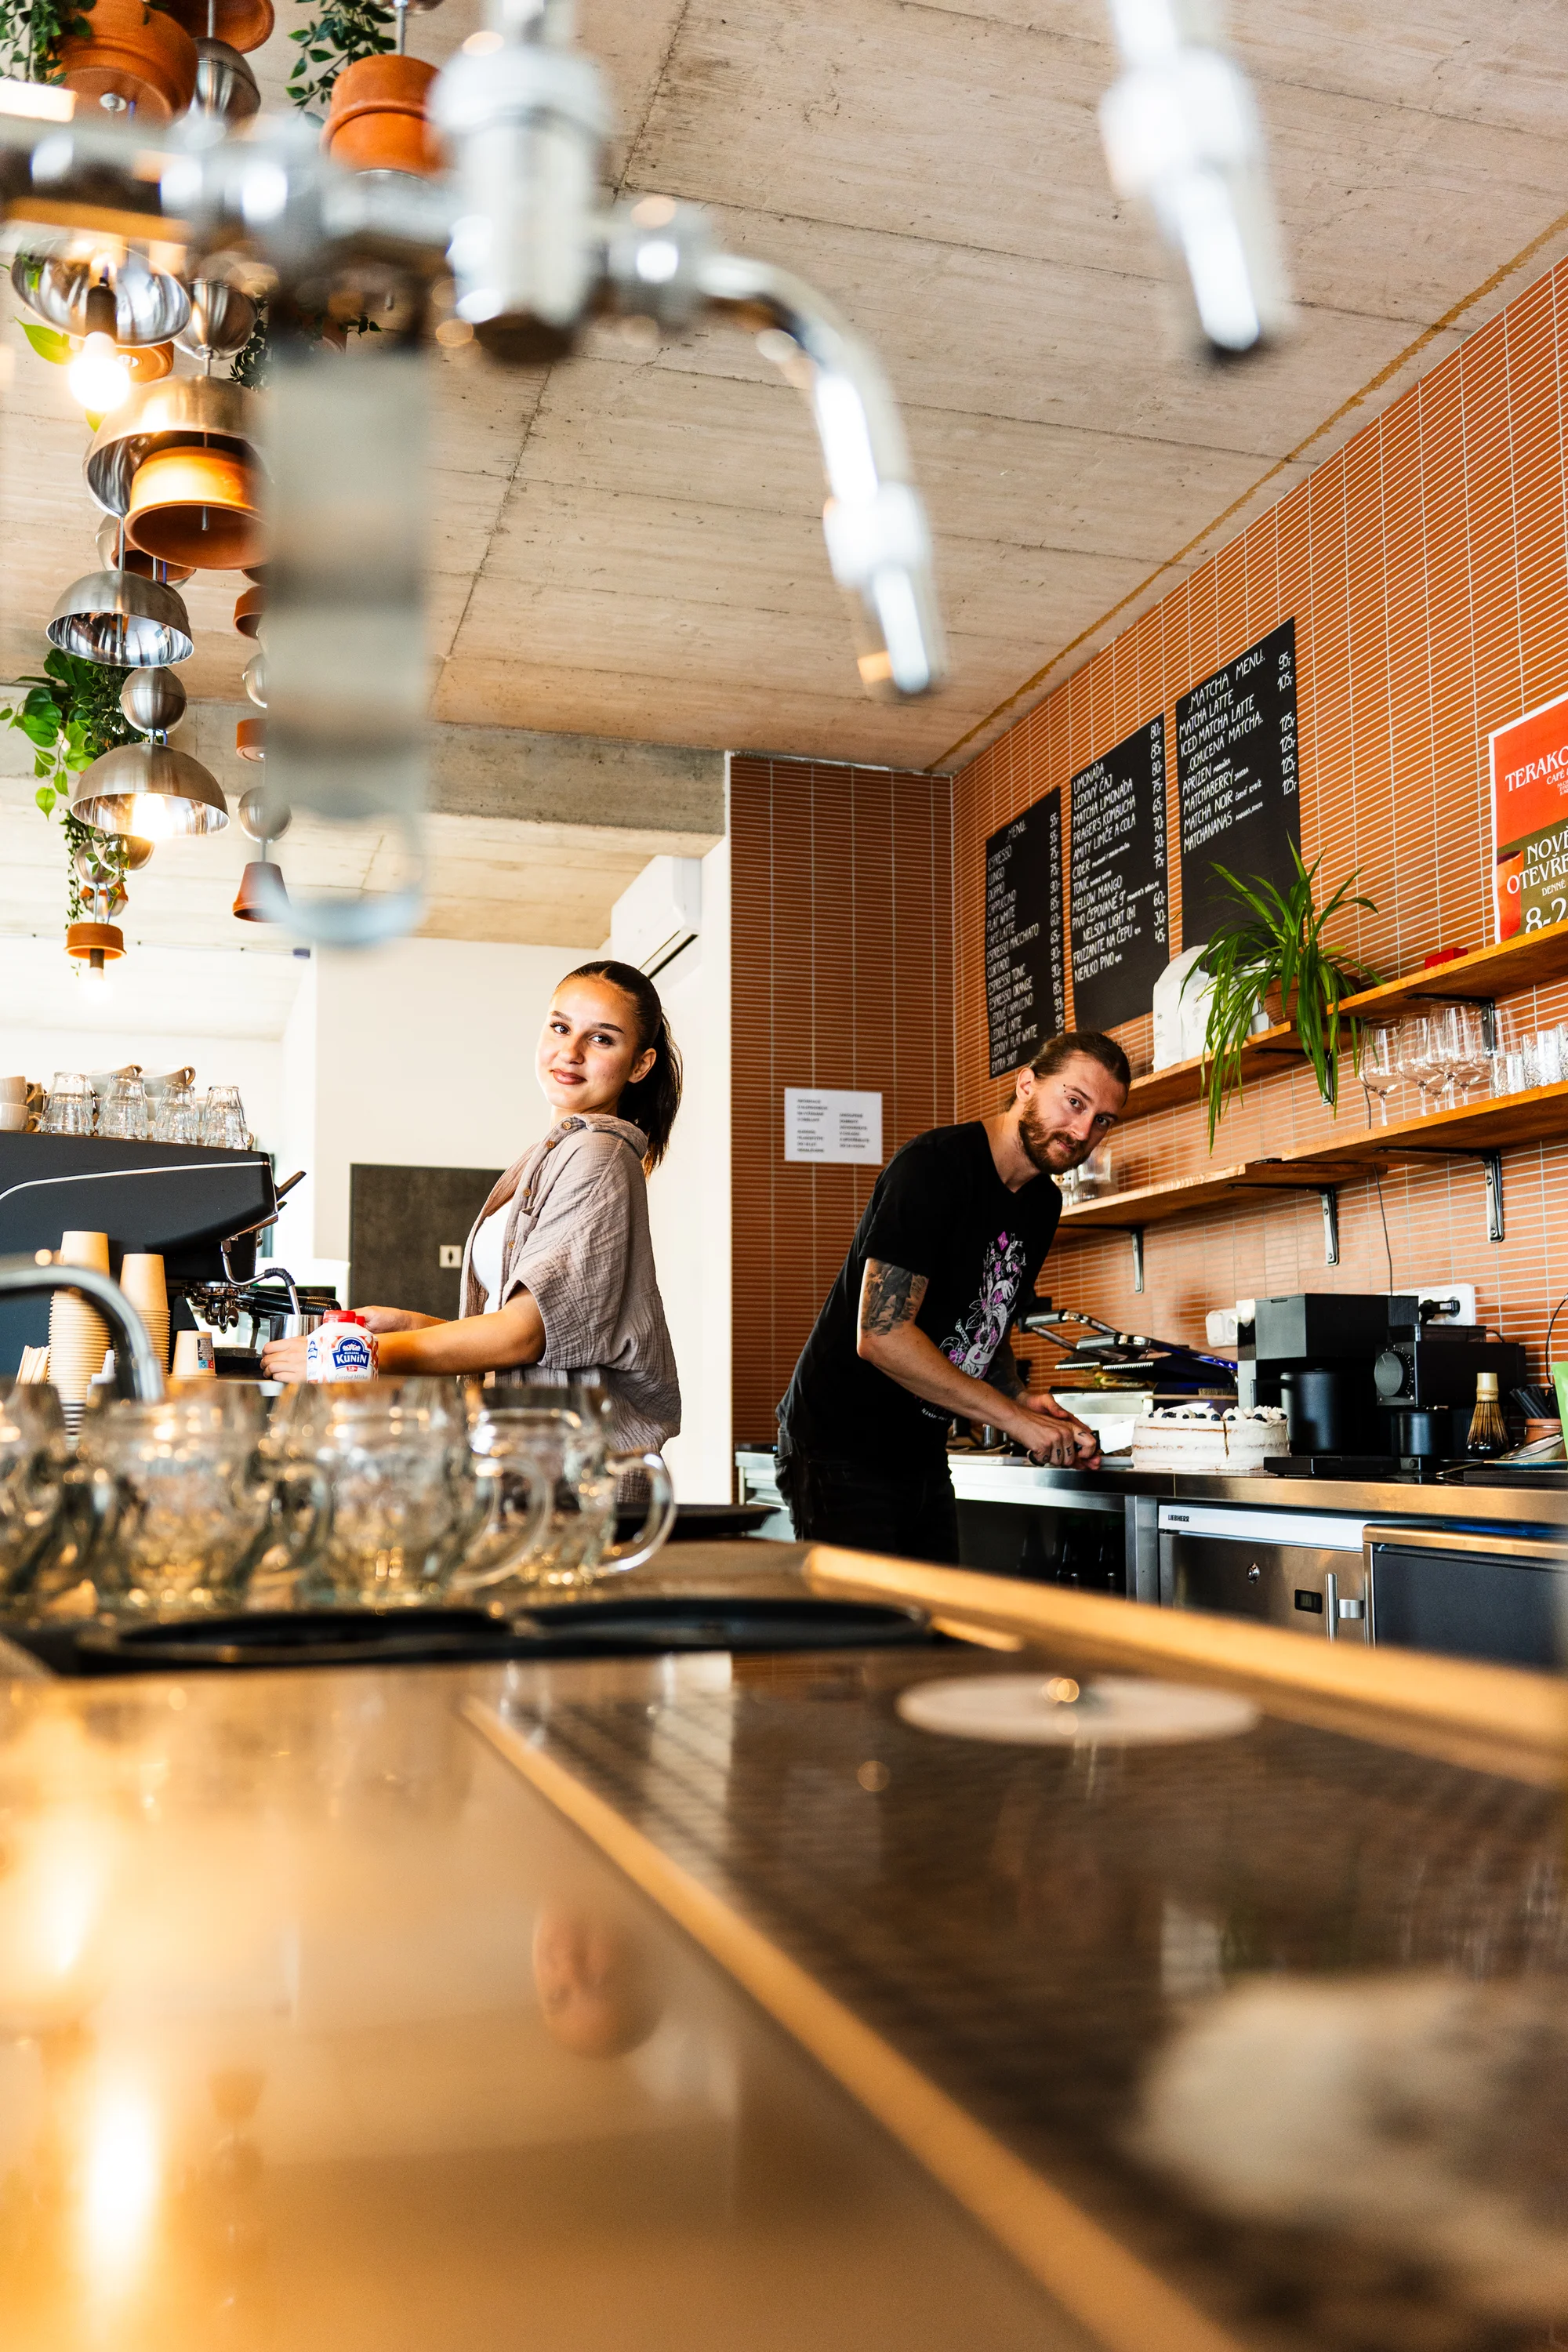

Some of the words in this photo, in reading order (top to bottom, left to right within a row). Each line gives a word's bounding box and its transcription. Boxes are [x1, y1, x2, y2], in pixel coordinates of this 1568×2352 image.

[1179, 708, 1207, 739] MATCHA
[1210, 689, 1233, 718] LATTE
[1181, 735, 1197, 757] ICED
[1200, 713, 1228, 744] MATCHA
[1232, 694, 1254, 723] LATTE
[1073, 762, 1104, 794] LIMONÁDA
[1182, 763, 1211, 797] APRIZEN
[1184, 768, 1233, 815] MATCHABERRY
[1546, 768, 1565, 784] CAFÉ
[1073, 801, 1098, 828] MATCHA
[1100, 778, 1132, 811] LIMONÁDA
[1074, 782, 1098, 811] LEDOVÝ
[1099, 774, 1112, 793] ČAJ
[1103, 795, 1135, 826] KOMBUCHA
[1184, 804, 1211, 834] MATCHA
[1215, 790, 1233, 813] NOIR
[1073, 840, 1092, 862] AMITY
[1115, 823, 1119, 837] A
[1120, 813, 1135, 832] COLA
[1184, 811, 1232, 854] MATCHANANAS
[988, 845, 1012, 871] ESPRESSO
[1073, 858, 1090, 880] CIDER
[988, 866, 1004, 886] LUNGO
[988, 881, 1004, 902] DOPPIO
[1073, 877, 1089, 895] TONIC
[988, 889, 1016, 916] CAPPUCCINO
[1073, 891, 1095, 914] MELLOW
[1098, 875, 1122, 900] MANGO
[987, 915, 999, 933] FLAT
[1000, 905, 1015, 924] WHITE
[1073, 913, 1085, 931] PIVO
[1087, 891, 1118, 923] ČEPOVANÉ
[1083, 920, 1106, 942] NELSON
[1109, 909, 1124, 929] LIGHT
[987, 941, 1008, 964] ESPRESSO
[1010, 923, 1039, 950] MACCHIATO
[1000, 920, 1015, 940] LATTE
[1073, 938, 1105, 966] FRIZZANTE
[1106, 933, 1116, 948] NA
[1116, 924, 1132, 943] ČEPU
[988, 956, 1009, 978] CORTADO
[988, 972, 1011, 996] ESPRESSO
[1011, 963, 1025, 981] TONIC
[1074, 960, 1098, 983] NEALKO
[1100, 951, 1113, 970] PIVO
[989, 989, 1011, 1011] ESPRESSO
[1013, 975, 1033, 997] ORANGE
[1007, 993, 1033, 1017] CAPPUCCINO
[1008, 1015, 1022, 1033] LATTE
[1011, 1032, 1021, 1047] FLAT
[1022, 1024, 1037, 1042] WHITE
[992, 1057, 1005, 1074] EXTRA
[1007, 1051, 1018, 1066] SHOT
